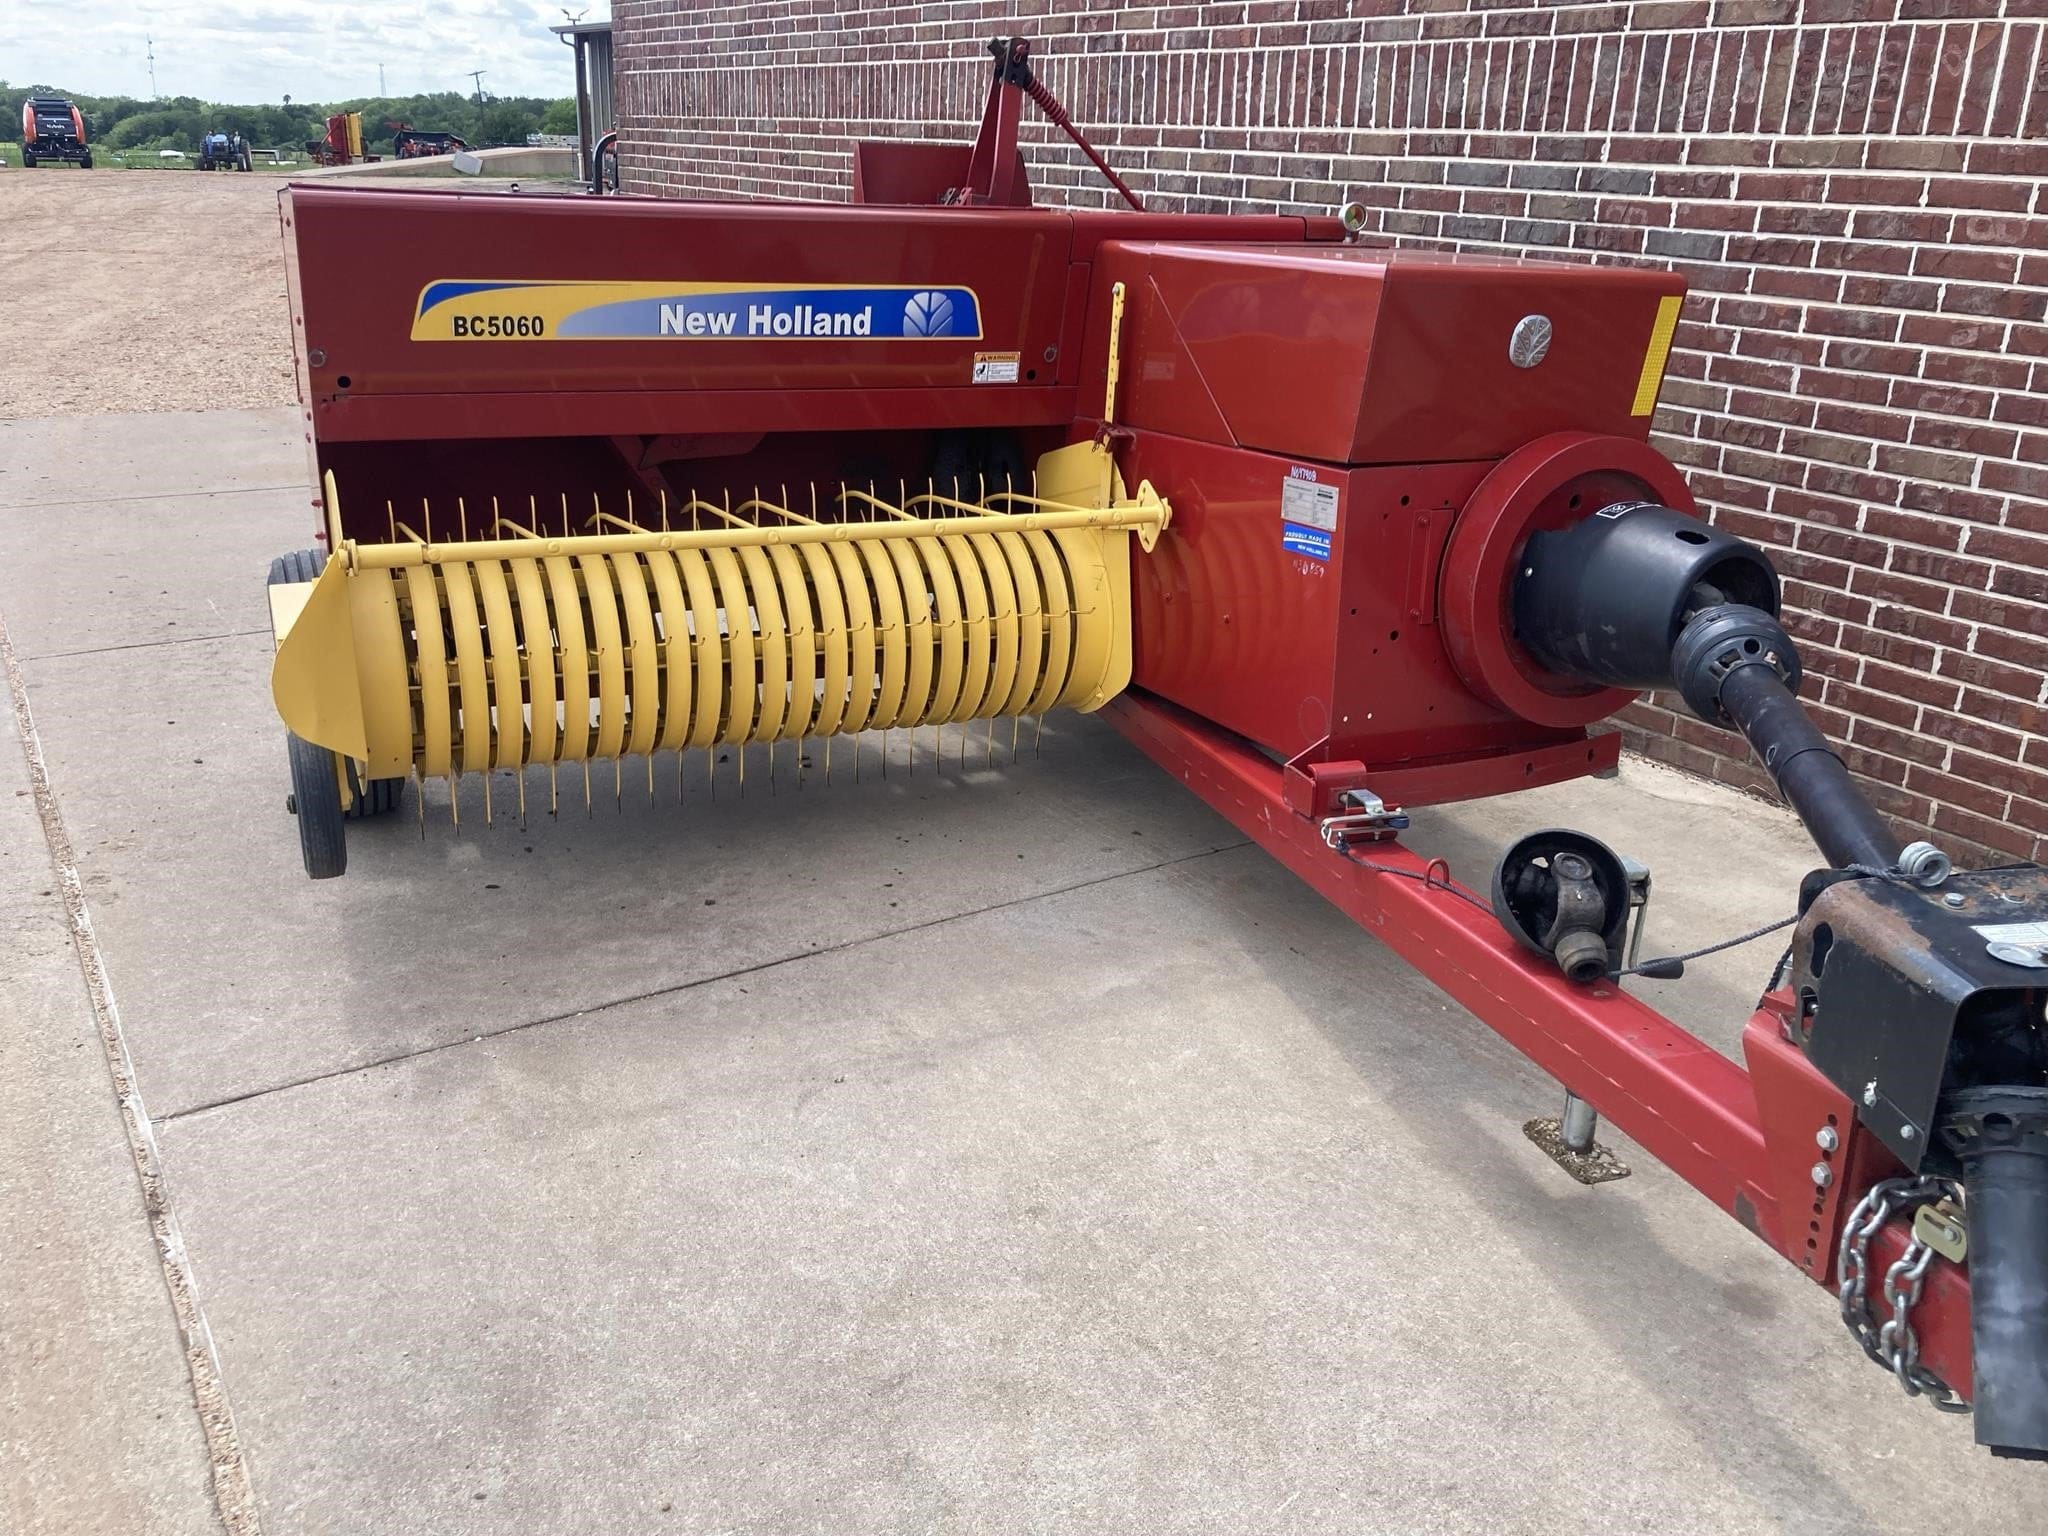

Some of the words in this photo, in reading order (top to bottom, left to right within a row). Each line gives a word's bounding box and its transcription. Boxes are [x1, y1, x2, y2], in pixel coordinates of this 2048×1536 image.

[453, 315, 545, 338] BC5060
[659, 304, 739, 336] New
[747, 306, 872, 337] Holland
[1285, 531, 1307, 539] PROUDLY
[1309, 534, 1322, 542] MADE
[1323, 536, 1330, 544] IN
